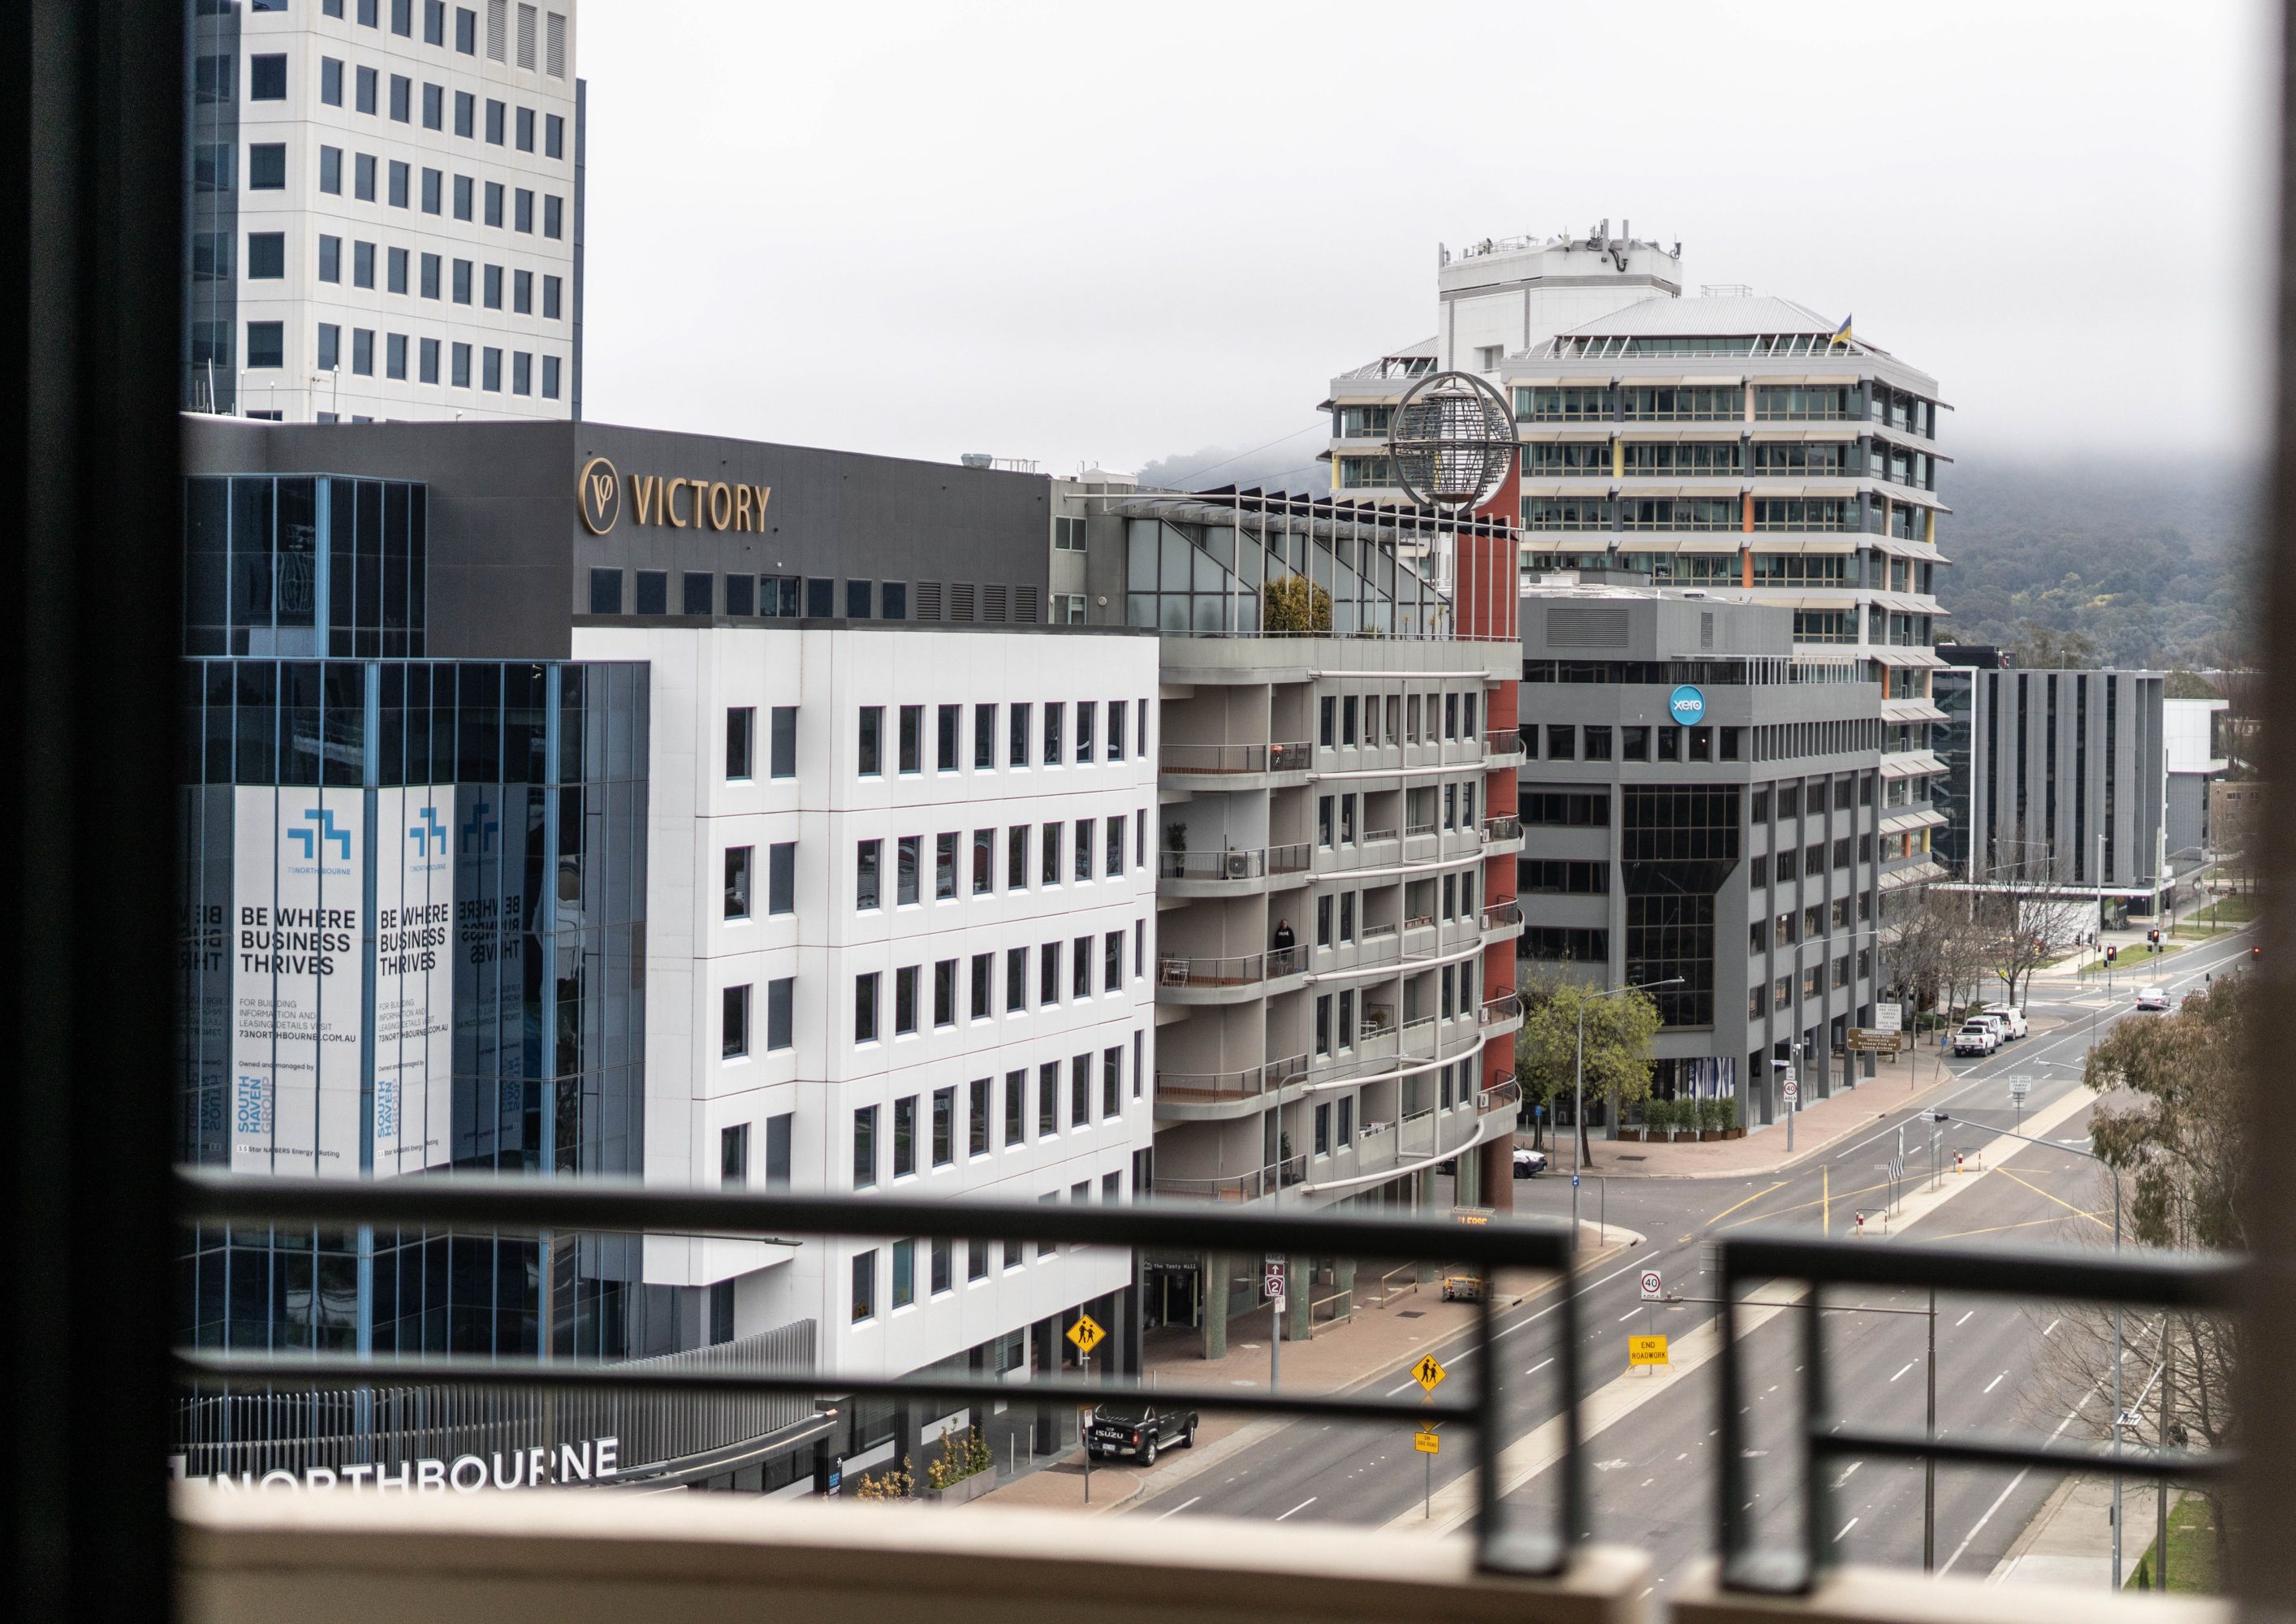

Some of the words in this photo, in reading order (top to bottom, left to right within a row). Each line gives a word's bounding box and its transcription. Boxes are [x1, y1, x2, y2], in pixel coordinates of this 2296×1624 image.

[628, 473, 771, 533] VICTORY
[1673, 700, 1703, 710] xero
[241, 906, 268, 926] BE
[276, 908, 356, 929] WHERE
[381, 909, 397, 929] BE
[401, 903, 449, 926] WHERE
[241, 930, 351, 952] BUSINESS
[380, 926, 445, 952] BUSINESS
[240, 953, 334, 975] THRIVES
[380, 951, 436, 976] THRIVES
[240, 998, 255, 1006] FOR
[258, 999, 297, 1009] BUILDING
[240, 1009, 296, 1019] INFORMATION
[299, 1012, 317, 1020] AND
[239, 1019, 273, 1029] LEASING
[276, 1021, 308, 1030] DETAILS
[311, 1022, 333, 1030] VSIT
[421, 1015, 434, 1026] VSIT
[238, 1076, 250, 1133] SOUTH
[250, 1078, 261, 1134] HAVEN
[261, 1076, 272, 1134] GROUP
[1271, 1281, 1279, 1293] 2
[1645, 1278, 1658, 1288] 40
[1632, 1351, 1666, 1359] ROADWORK
[1095, 1429, 1124, 1439] ISUZU
